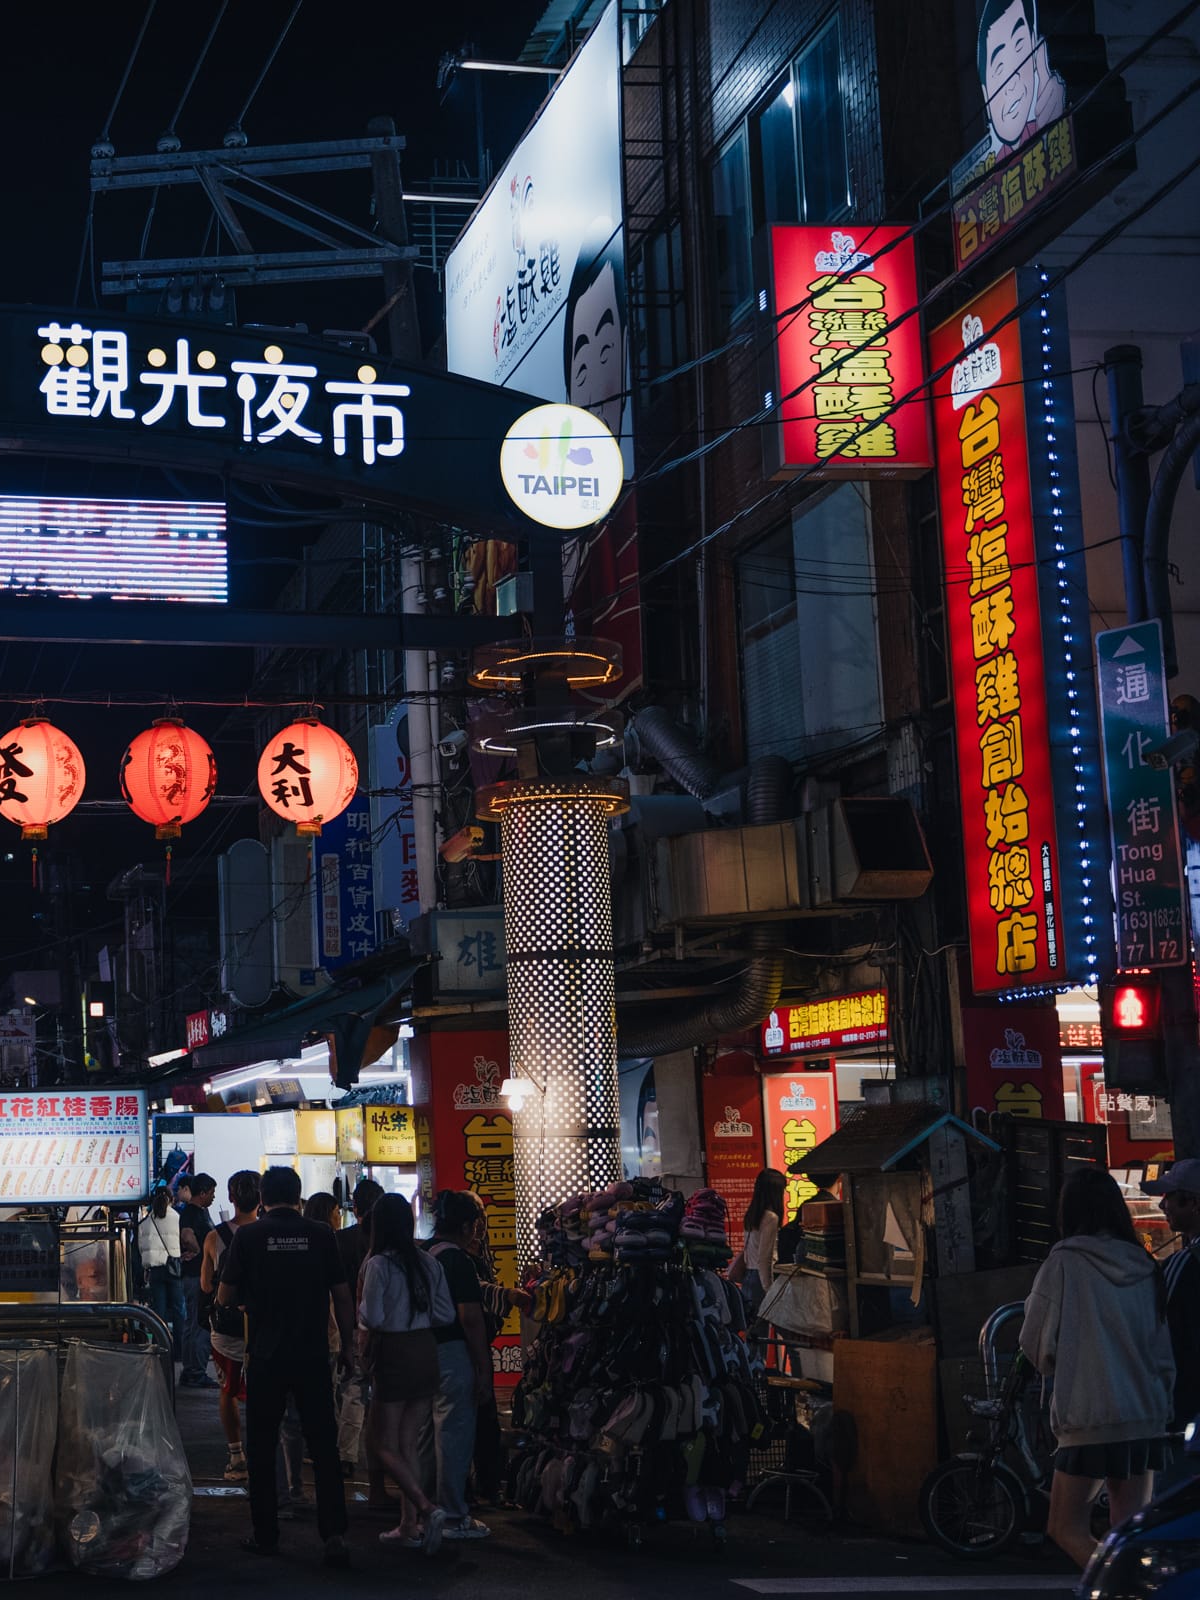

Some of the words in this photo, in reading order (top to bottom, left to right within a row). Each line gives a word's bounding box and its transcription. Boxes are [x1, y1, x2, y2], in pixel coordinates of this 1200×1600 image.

[959, 117, 1072, 261] 台灣塩酥雞
[808, 274, 898, 459] 台灣塩酥雞
[37, 322, 411, 466] 觀光夜市
[518, 474, 599, 497] TAIPEI
[959, 393, 1038, 976] 台灣塩酥雞創始總店
[1116, 662, 1162, 837] 通化街
[271, 742, 314, 808] 大利
[1117, 842, 1164, 863] Tong
[346, 812, 375, 957] 明和百貨皮件
[1121, 866, 1156, 885] Hua
[1122, 890, 1145, 908] St.
[1121, 910, 1149, 931] 163
[457, 930, 503, 978] 雄
[1127, 943, 1145, 963] 77
[1159, 940, 1178, 960] 72
[1099, 1093, 1151, 1112] 點餐處
